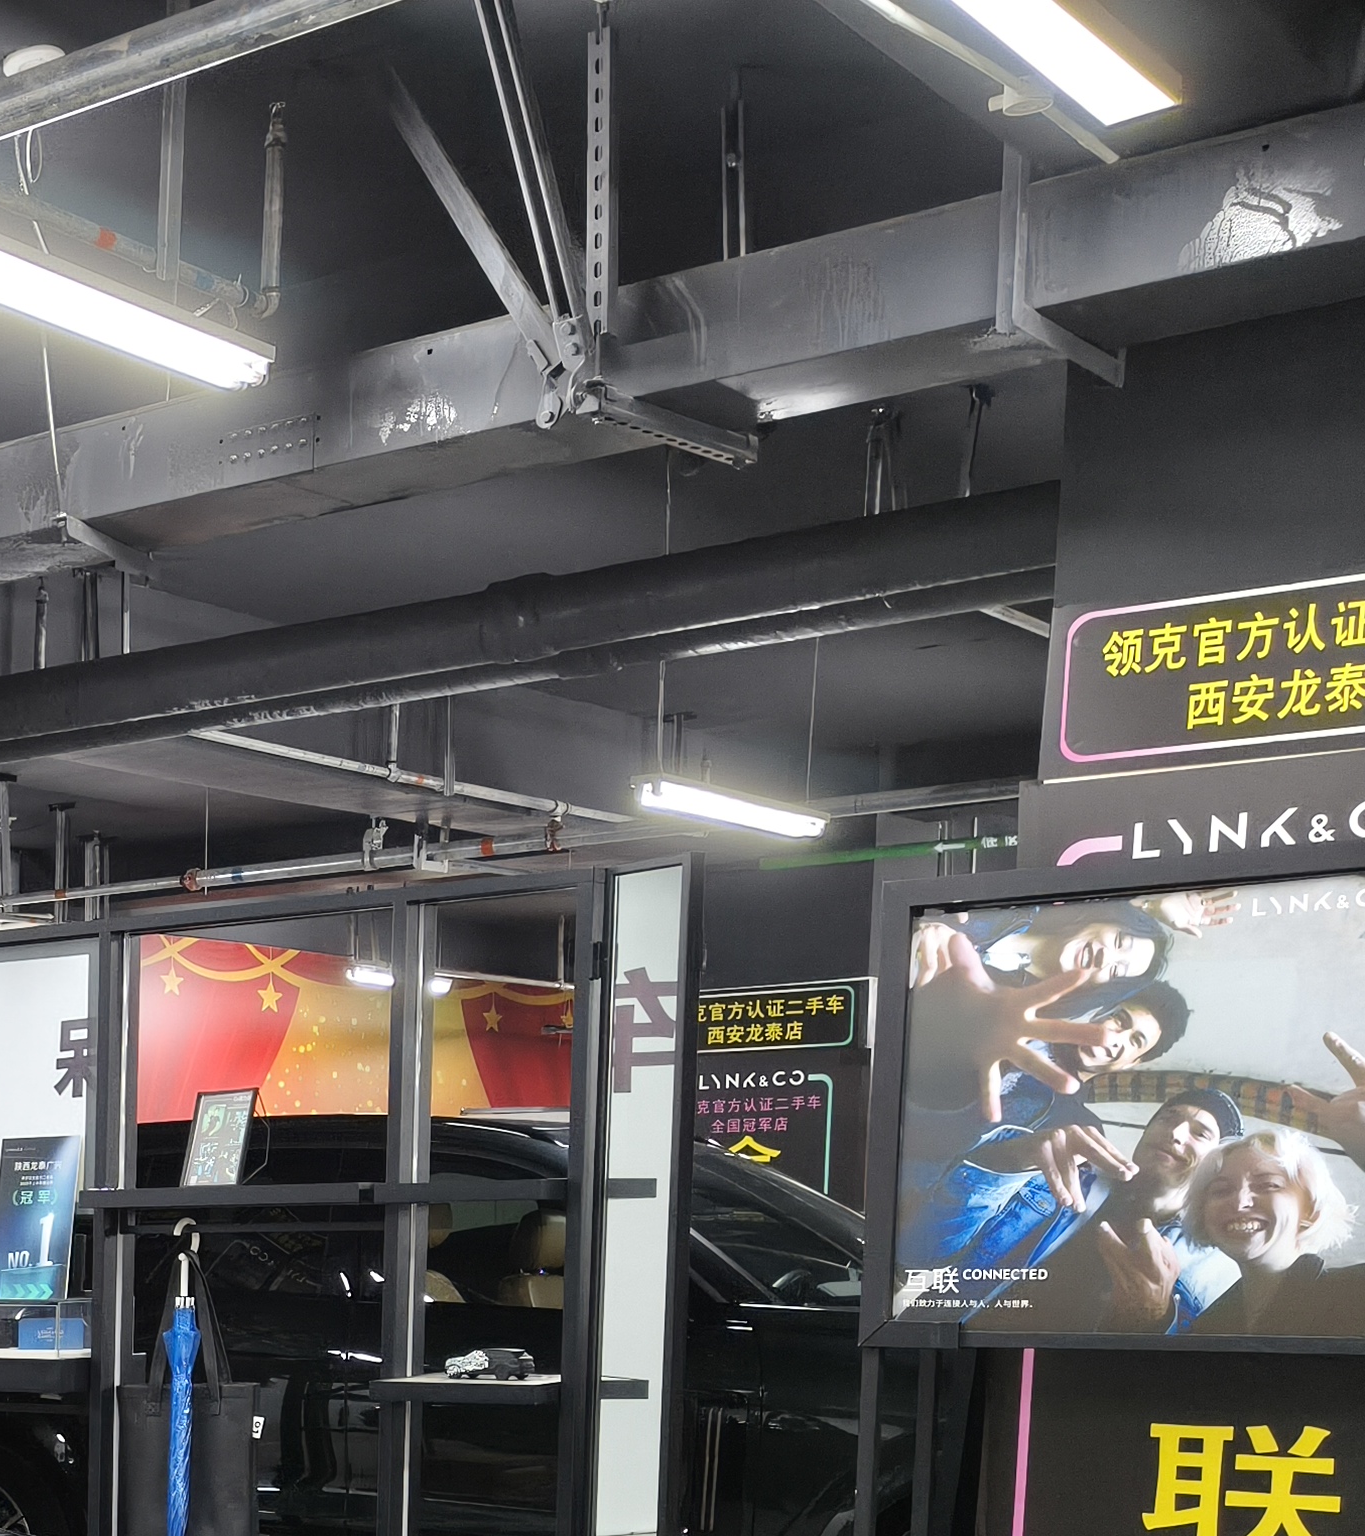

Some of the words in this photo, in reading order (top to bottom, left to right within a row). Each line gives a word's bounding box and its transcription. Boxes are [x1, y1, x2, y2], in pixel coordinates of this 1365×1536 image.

[1102, 602, 1365, 677] 领克官方认证
[1187, 663, 1365, 730] 西安龙泰
[707, 1021, 804, 1045] 西安龙泰店
[699, 1070, 805, 1090] LYNK&CO
[710, 1117, 788, 1133] 全国冠军店
[903, 1266, 959, 1293] 互联
[963, 1268, 1048, 1280] CONNECTED
